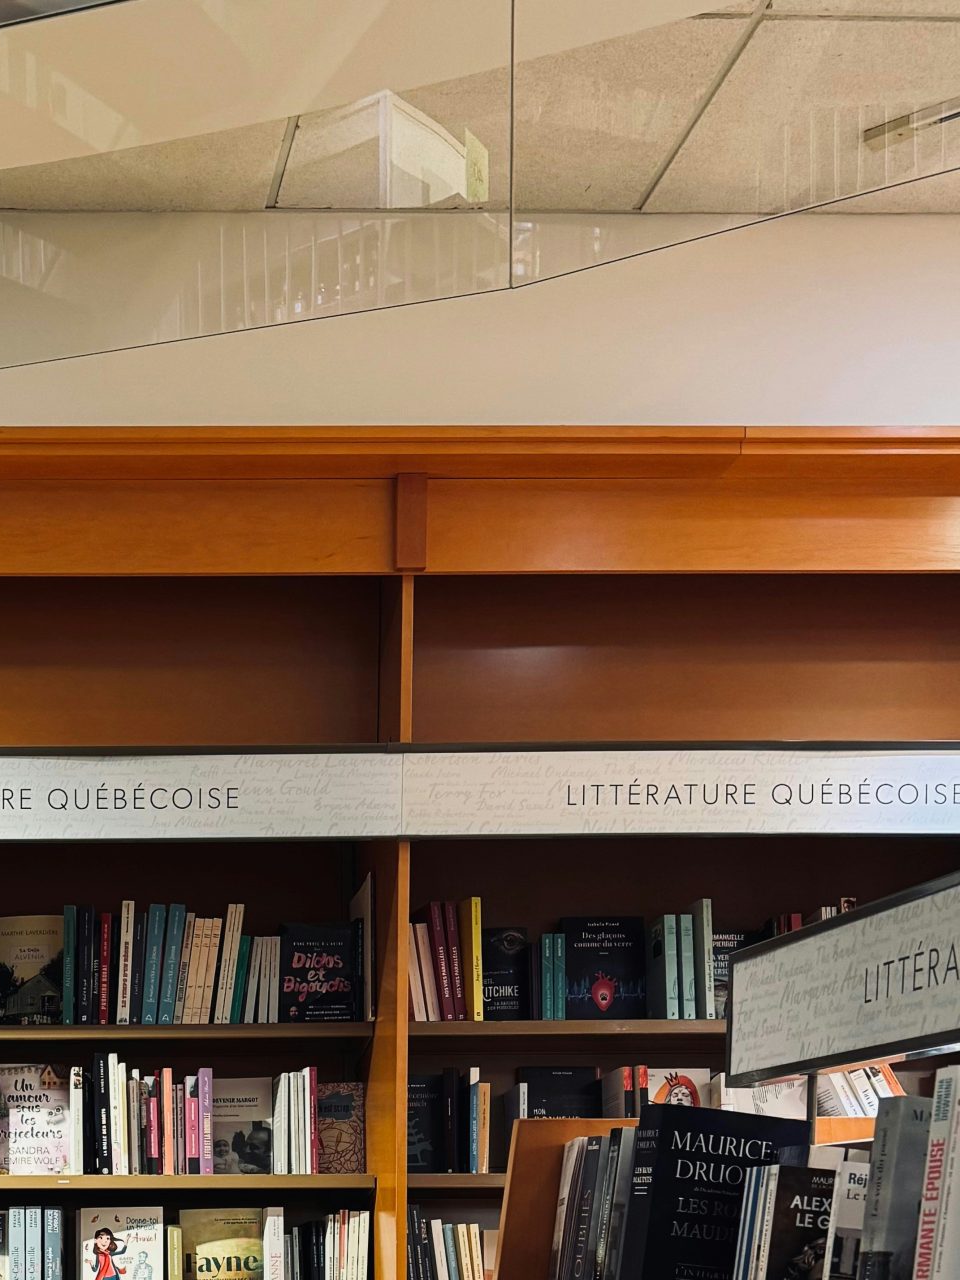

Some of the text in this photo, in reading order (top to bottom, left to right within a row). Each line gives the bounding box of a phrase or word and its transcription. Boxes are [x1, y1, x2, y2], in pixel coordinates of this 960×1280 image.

[47, 782, 240, 811] QUÉBÉCOISE
[567, 778, 960, 807] LITTÉRATURE QUÉBÉCOISE
[8, 1145, 50, 1155] SANDRA
[671, 1130, 773, 1161] MAURICE
[675, 1157, 745, 1186] DRUO
[923, 1138, 946, 1202] ÉPOUSE
[676, 1197, 709, 1215] LES
[795, 1213, 814, 1229] LE
[185, 1252, 259, 1278] Fayne
